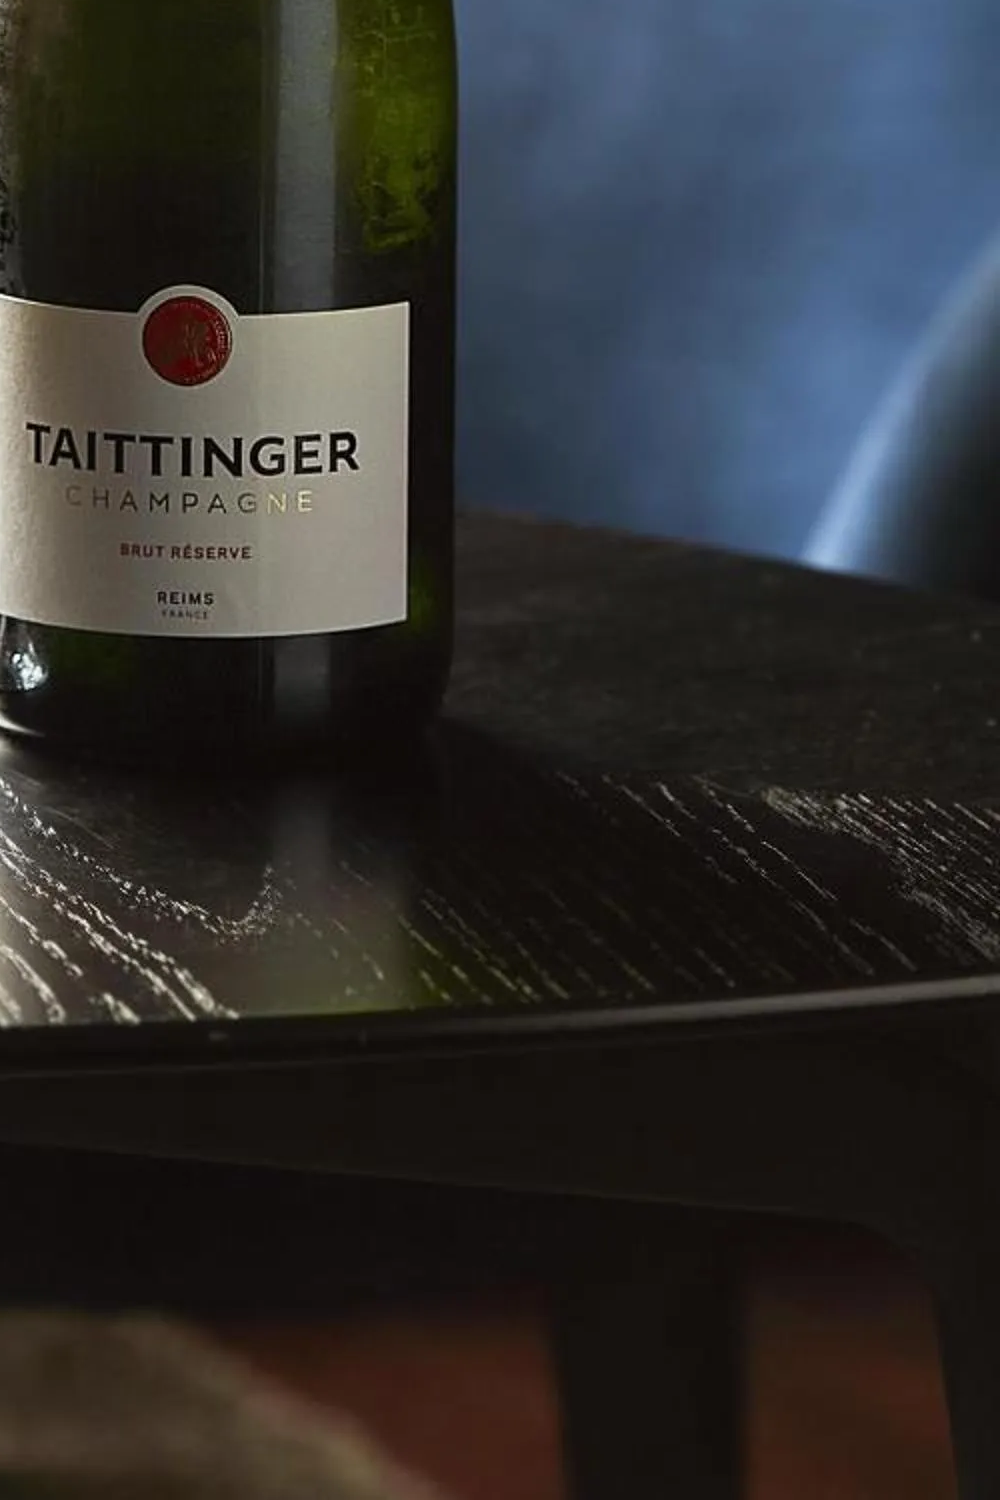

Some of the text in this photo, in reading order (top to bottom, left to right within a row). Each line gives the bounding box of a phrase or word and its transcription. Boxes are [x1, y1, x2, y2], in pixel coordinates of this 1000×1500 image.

[25, 421, 360, 478] TAITTINGER
[65, 485, 314, 515] CHAMPAGNE
[119, 542, 252, 560] BRUT RÉSERVE
[156, 590, 215, 606] REIMS
